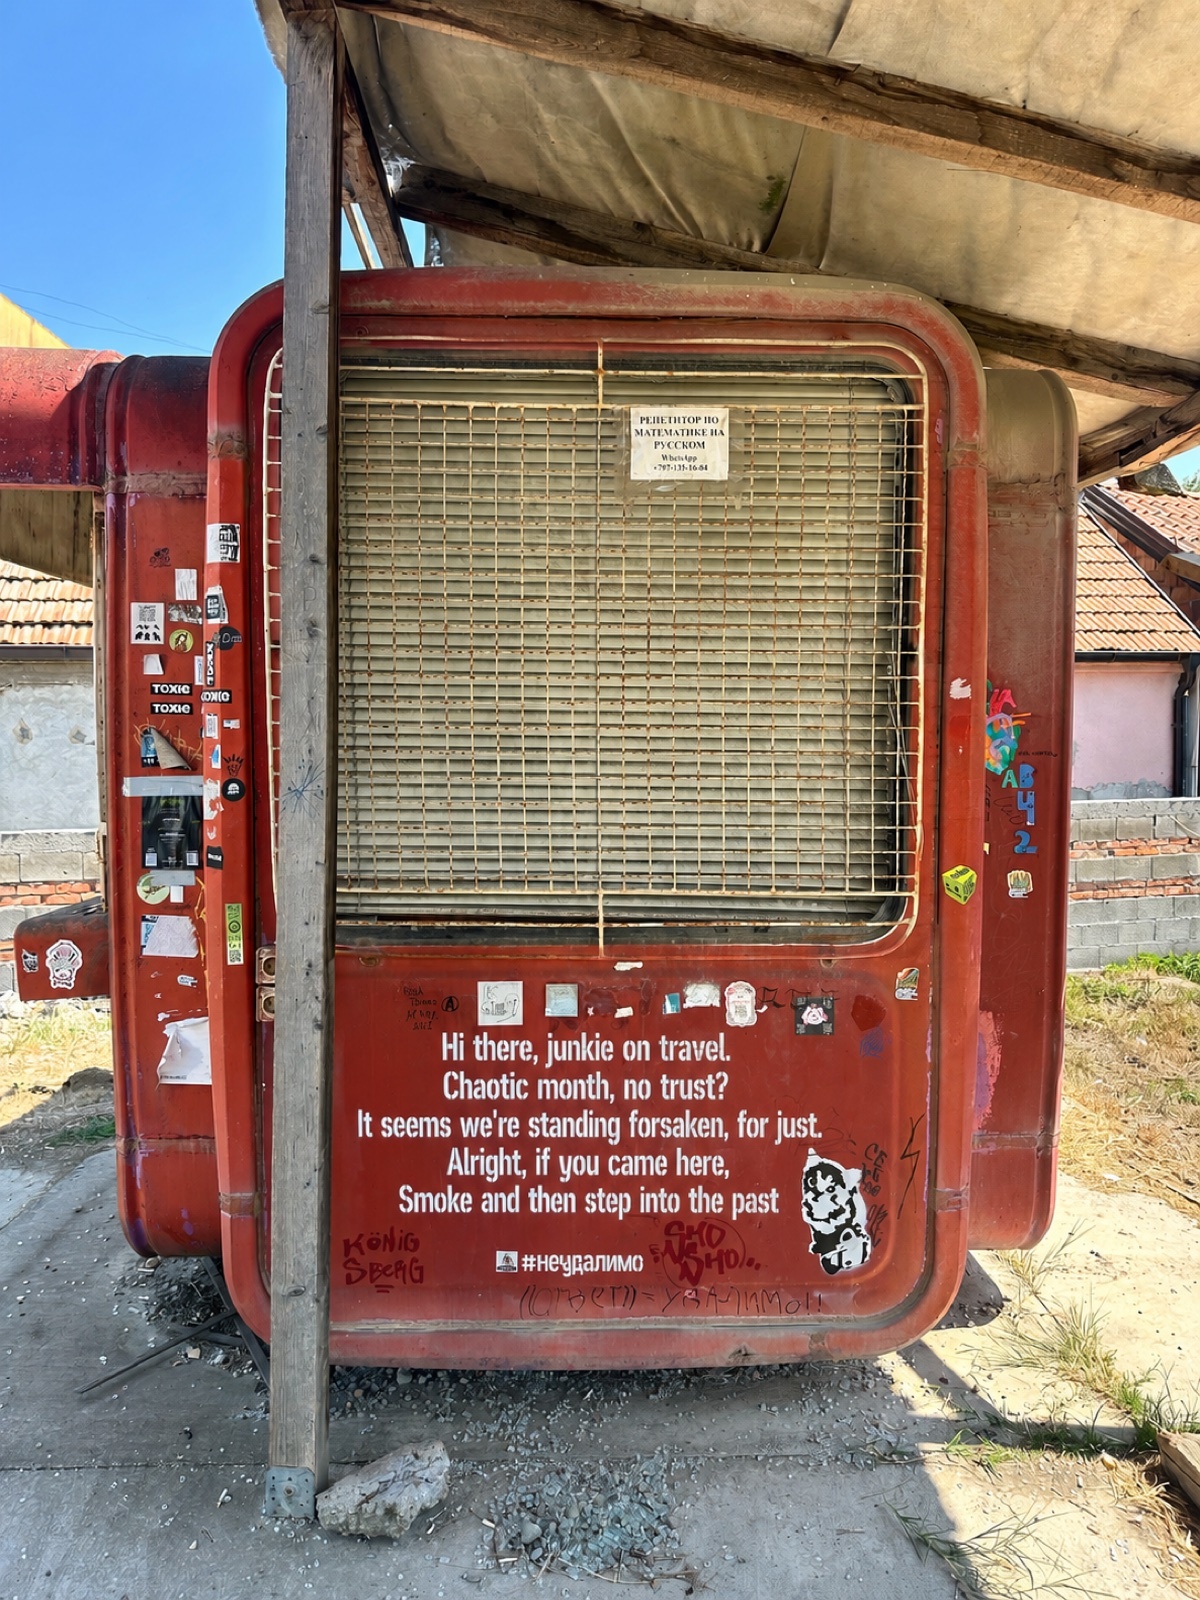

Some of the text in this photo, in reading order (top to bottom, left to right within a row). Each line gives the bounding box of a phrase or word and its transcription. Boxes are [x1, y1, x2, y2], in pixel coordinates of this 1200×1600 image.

[640, 415, 719, 425] РЕПЕТИТОР ПО
[634, 428, 725, 437] МАТЕМАТИКЕ НА
[654, 440, 705, 450] РУССКОМ
[152, 684, 190, 694] TOXIC
[152, 704, 191, 714] TOXIC
[442, 1032, 731, 1068] Hi there, junkie on travel.
[443, 1071, 729, 1104] Chaotic month, no trust?
[357, 1109, 823, 1146] It seems we're standing forsaken, for just.
[446, 1147, 730, 1183] Alright, if you came here,
[398, 1185, 780, 1220] Smoke and then step into the past
[521, 1254, 644, 1277] #неудалимо
